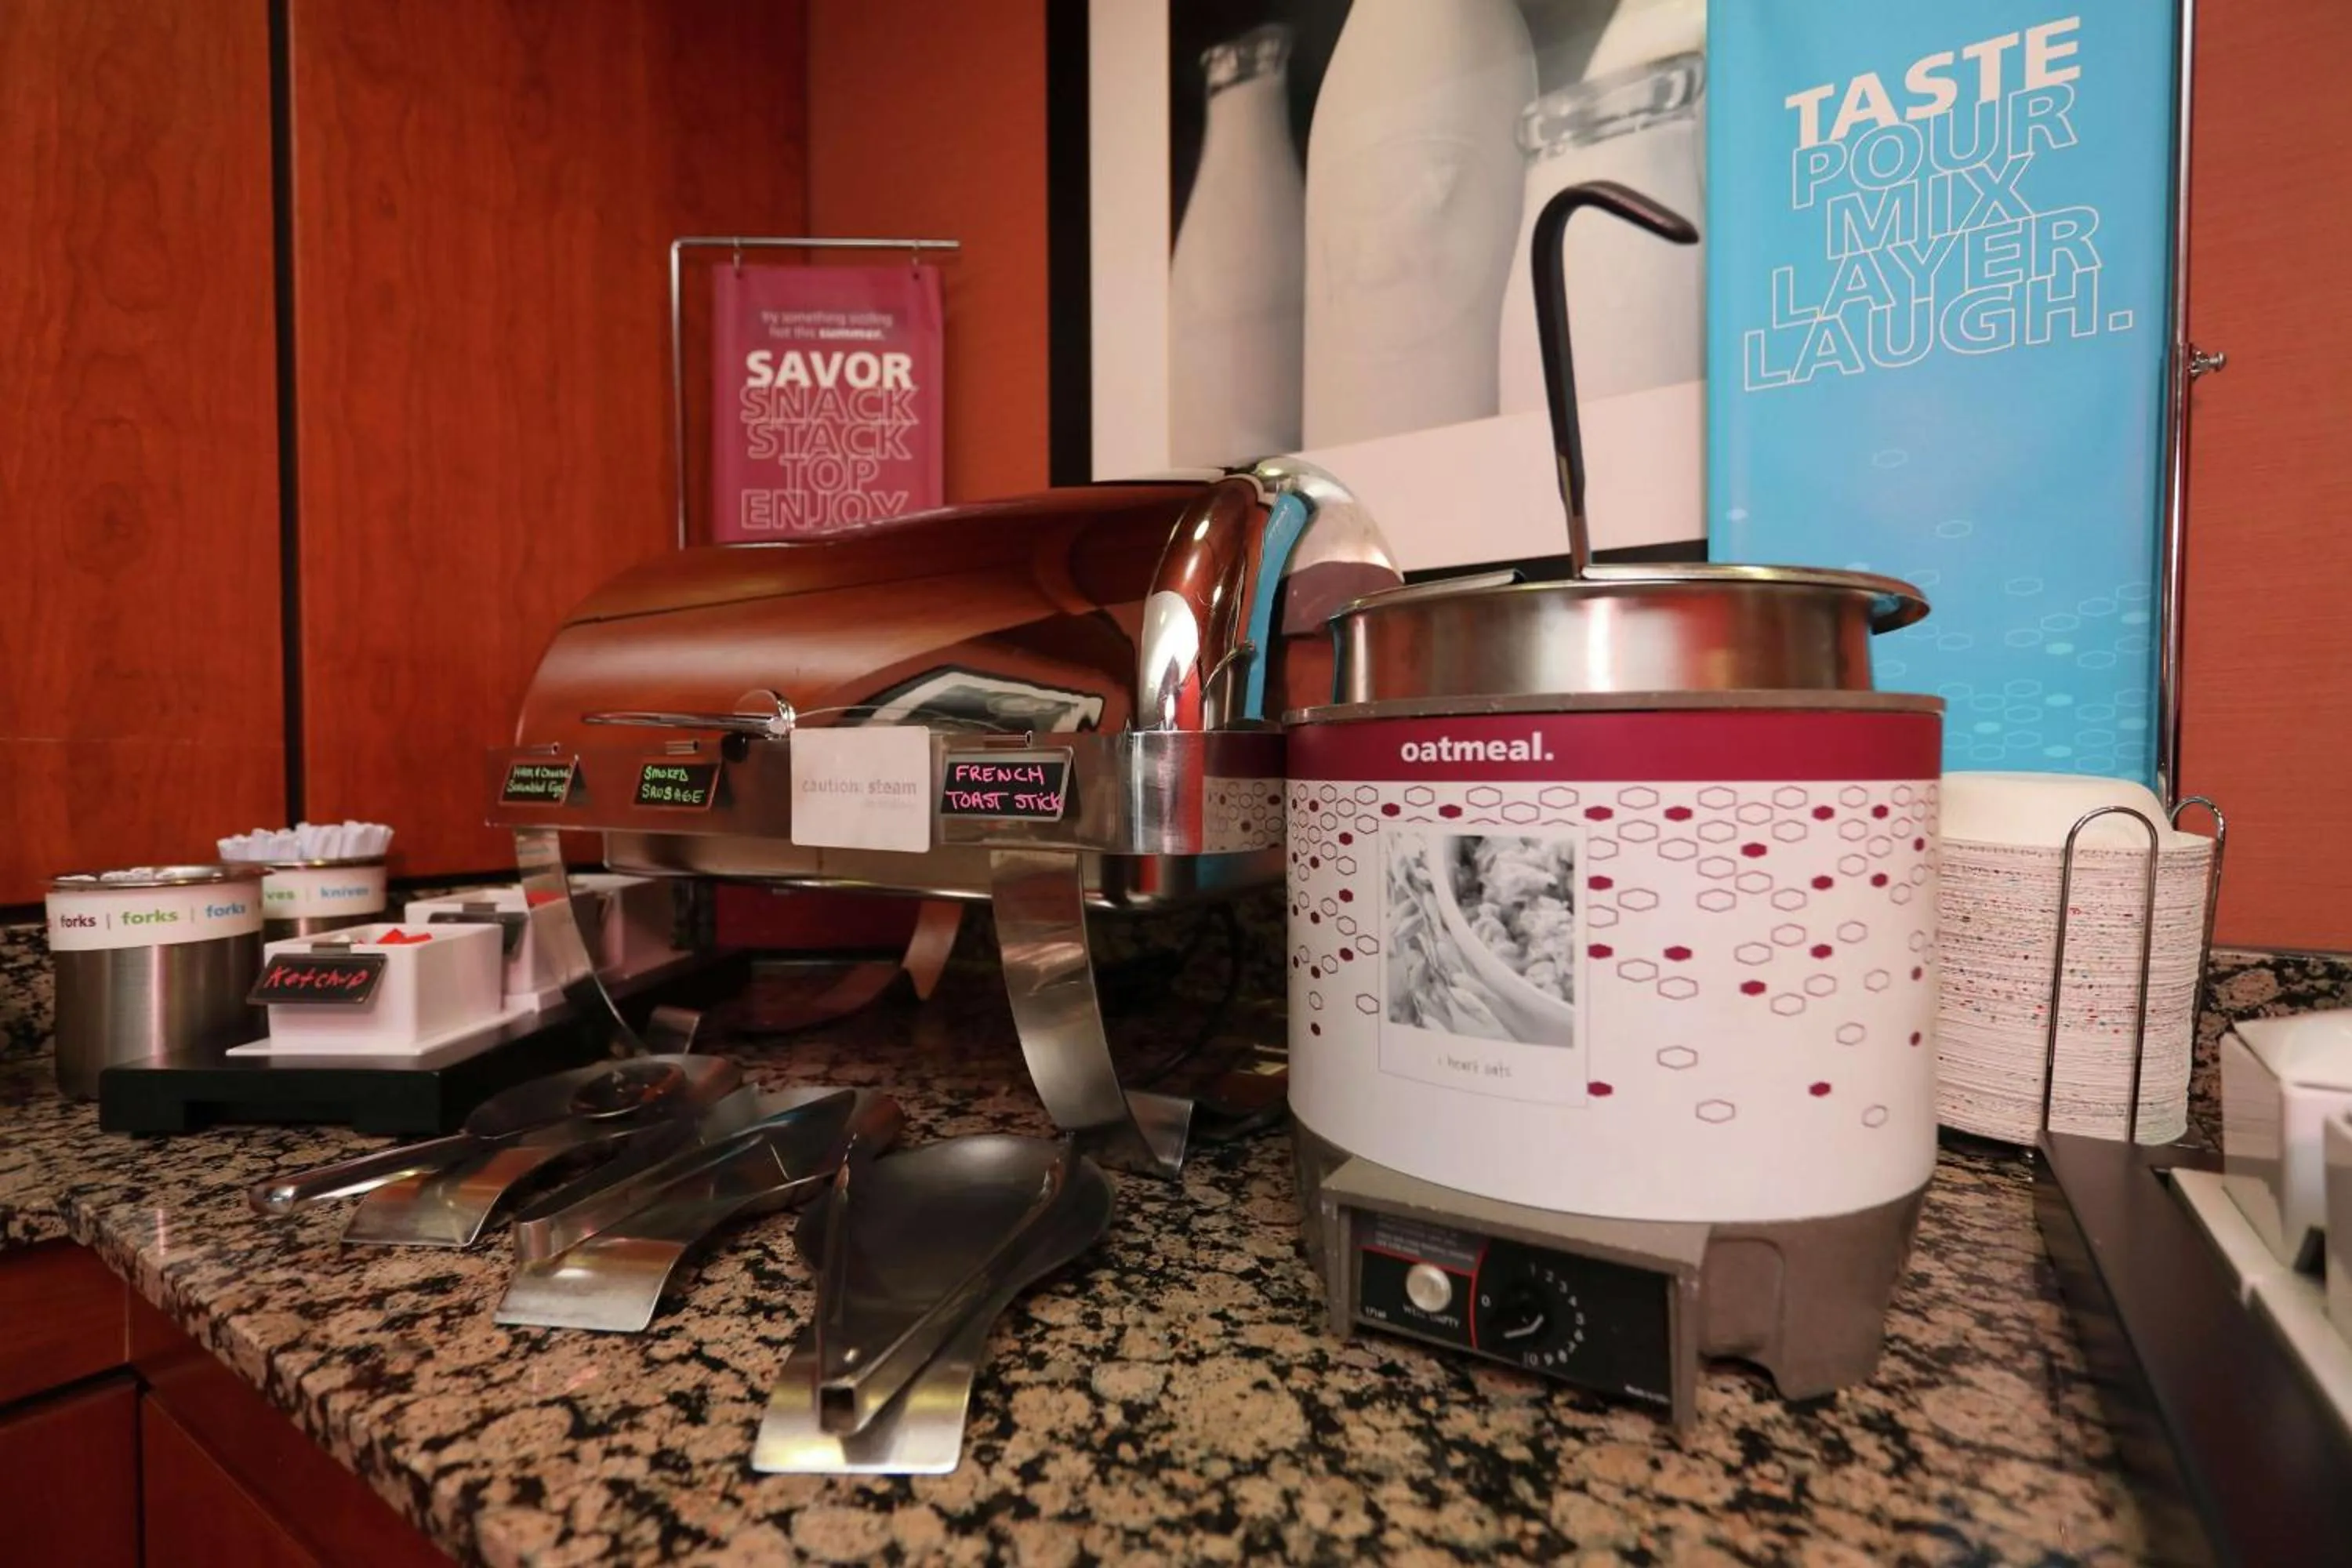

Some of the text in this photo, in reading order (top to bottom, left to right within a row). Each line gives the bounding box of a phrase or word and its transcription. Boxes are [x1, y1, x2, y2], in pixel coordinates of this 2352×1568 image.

[1785, 16, 2080, 149] TASTE
[1792, 82, 2078, 209] POUR
[1828, 152, 2035, 260] MIX
[1773, 206, 2101, 328] LAYER
[1745, 267, 2132, 391] LAUGH.
[746, 350, 913, 388] SAVOR
[740, 385, 920, 424] SNACK
[747, 419, 913, 460] STACK
[779, 452, 880, 495] TOP
[742, 489, 909, 529] ENJOY
[1400, 731, 1555, 762] oatmeal.
[868, 779, 916, 795] steam
[956, 765, 1044, 786] FRENCH
[946, 790, 1009, 811] TOAST
[320, 886, 369, 898] knives
[60, 914, 96, 928] forks
[121, 909, 179, 926] forks
[205, 902, 245, 918] forks
[1481, 1294, 1490, 1307] 0
